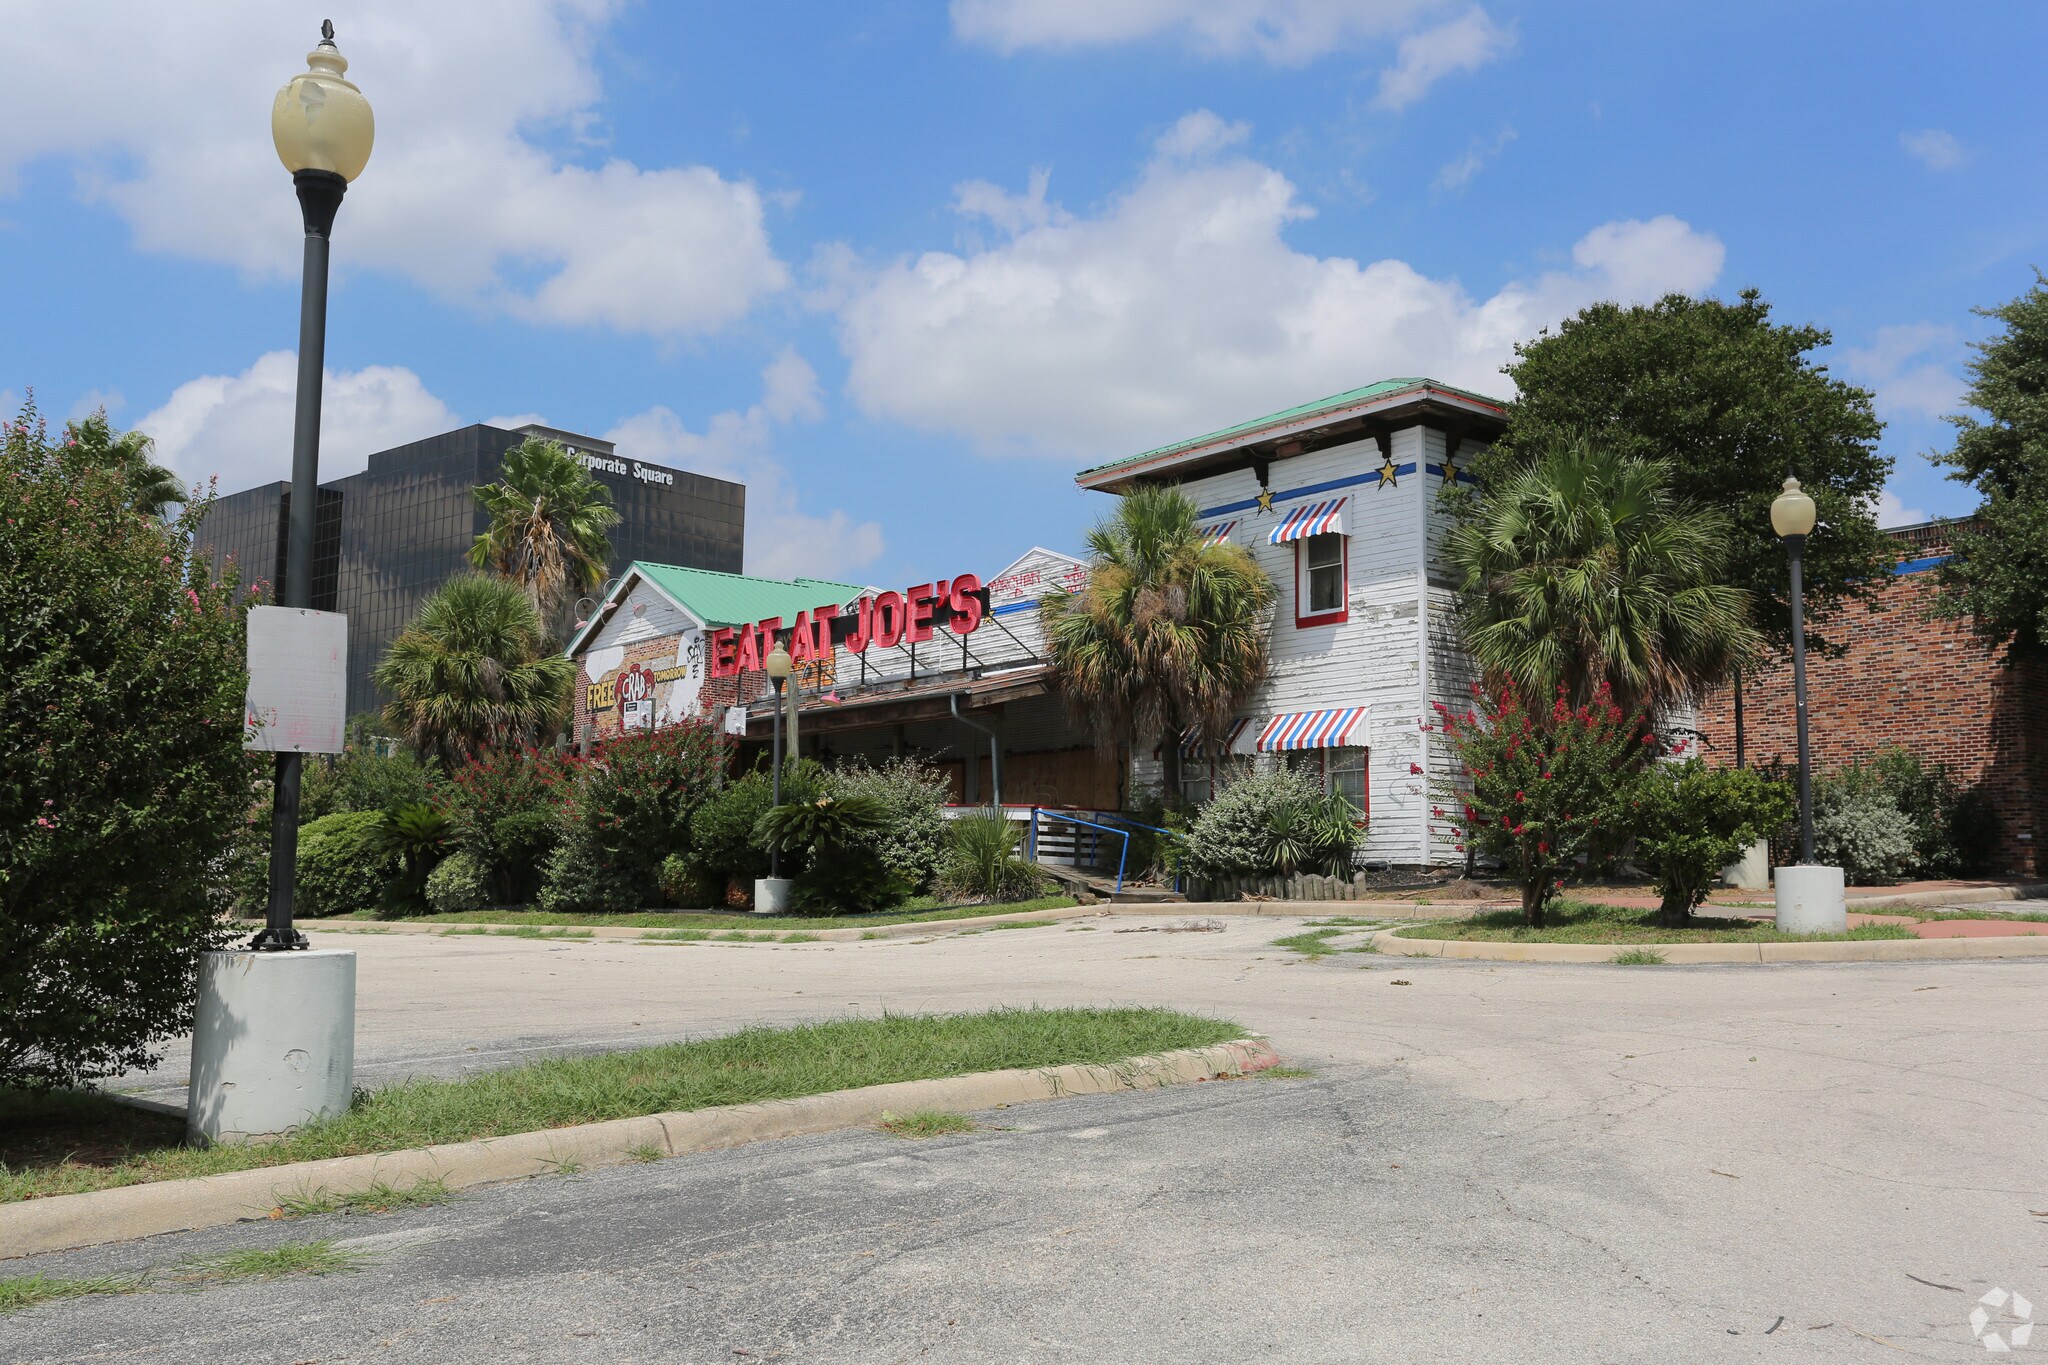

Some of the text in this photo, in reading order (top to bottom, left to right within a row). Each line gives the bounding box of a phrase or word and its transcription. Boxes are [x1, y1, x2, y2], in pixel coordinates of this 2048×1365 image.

[633, 462, 673, 486] Square
[712, 616, 783, 678] EAT
[790, 604, 839, 664] AT
[845, 573, 982, 654] JOE'S
[586, 665, 687, 712] FREE CRAB TOMORROW
